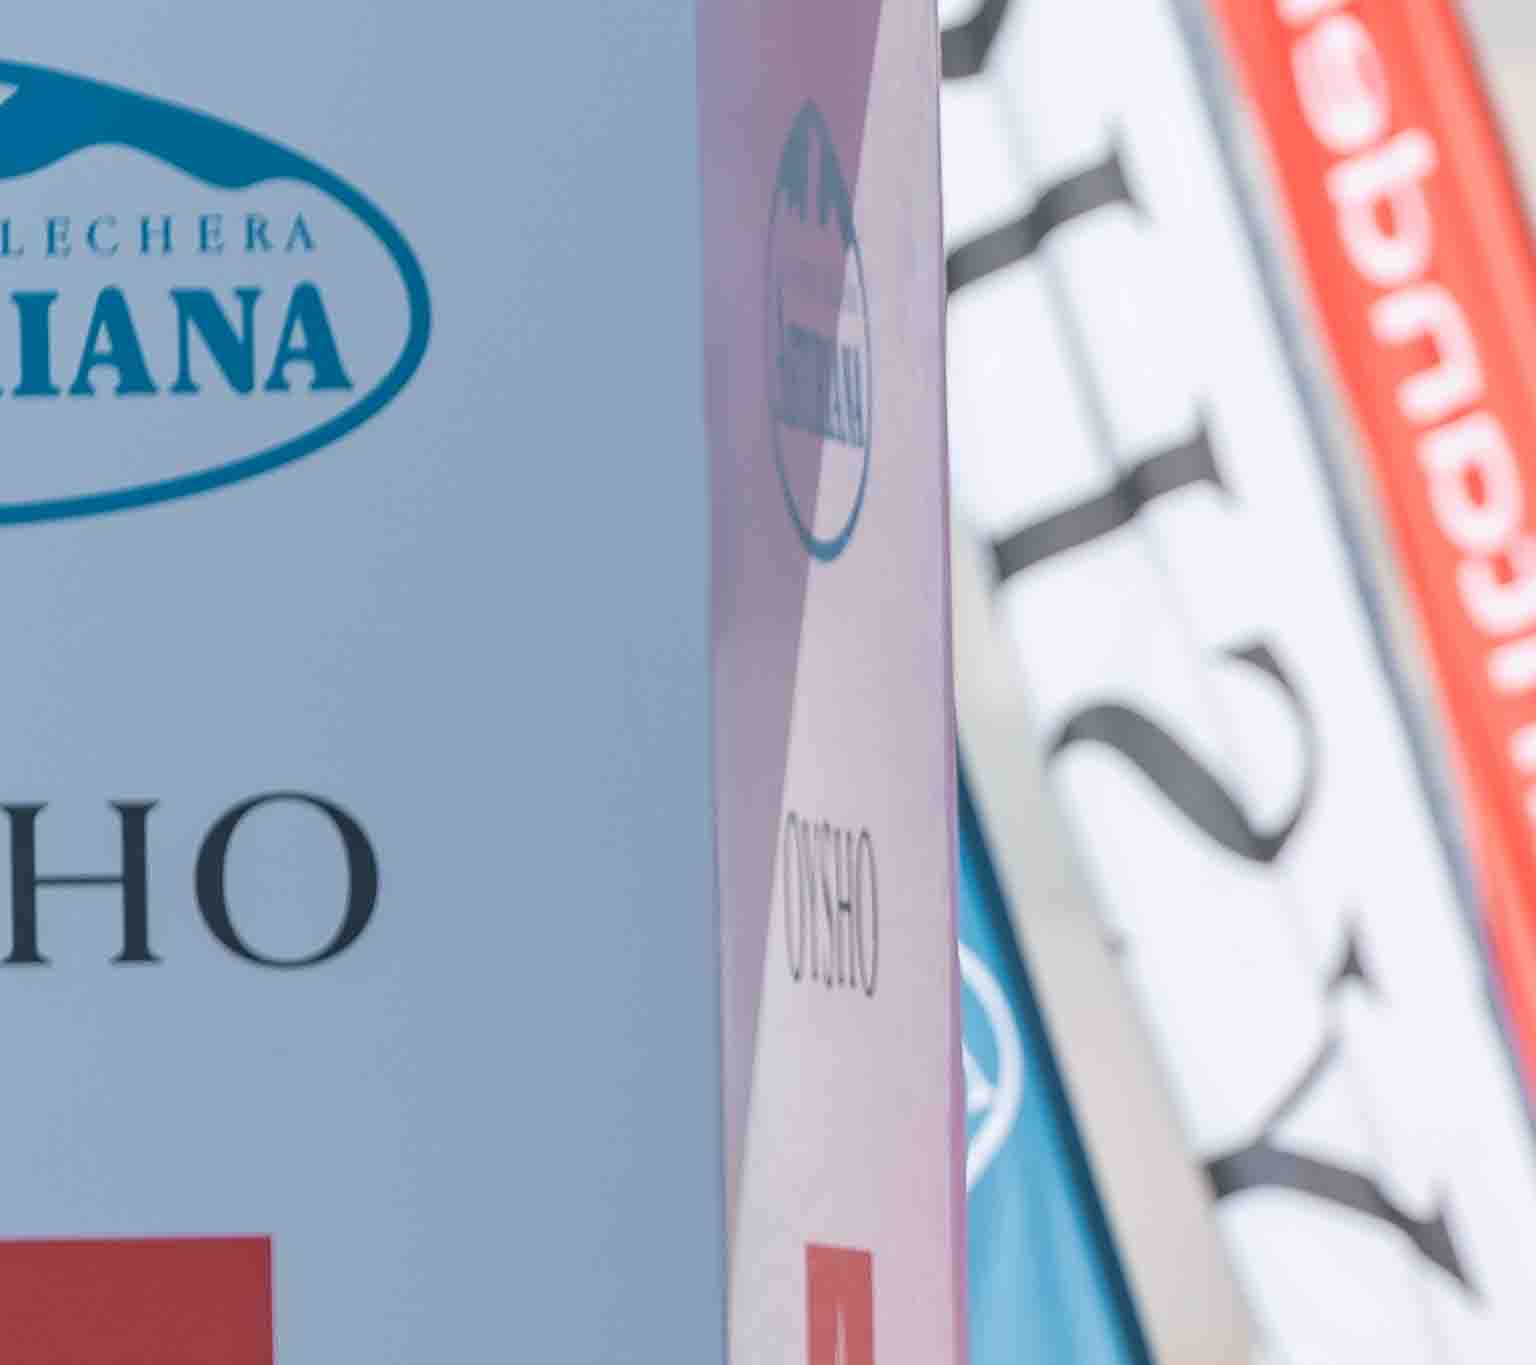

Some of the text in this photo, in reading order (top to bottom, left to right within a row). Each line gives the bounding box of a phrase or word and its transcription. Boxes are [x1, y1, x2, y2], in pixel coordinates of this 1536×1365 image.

[1, 214, 318, 258] LECHERA
[0, 280, 355, 398] IANA
[783, 810, 879, 998] OYSHO
